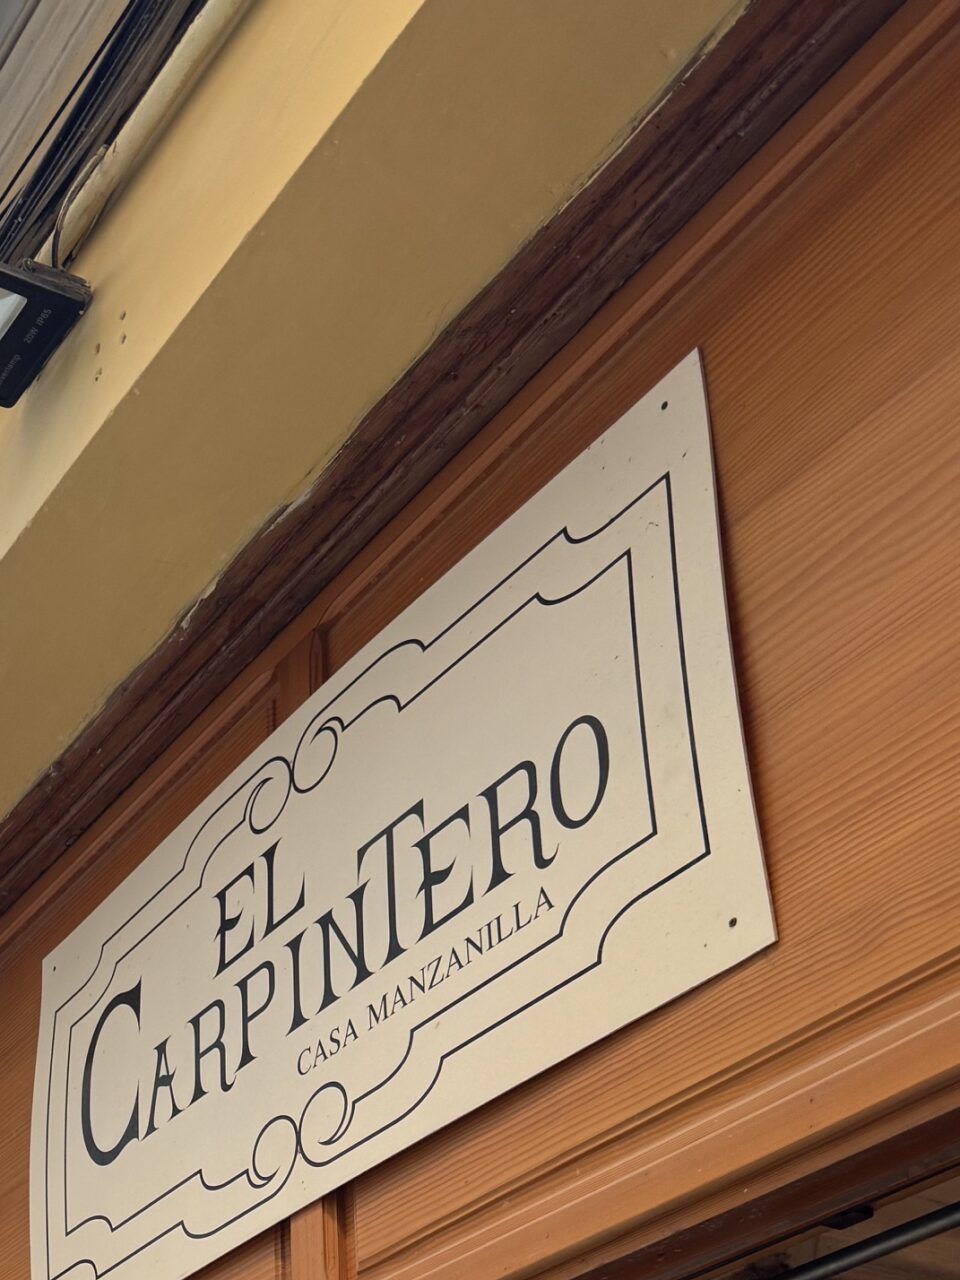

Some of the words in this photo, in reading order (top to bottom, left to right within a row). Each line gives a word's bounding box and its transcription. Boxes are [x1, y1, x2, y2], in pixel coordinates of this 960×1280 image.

[80, 714, 609, 1165] CARPINTERO
[212, 838, 305, 979] EL
[297, 1018, 359, 1077] CASA
[367, 886, 555, 1031] MANZANILLA
